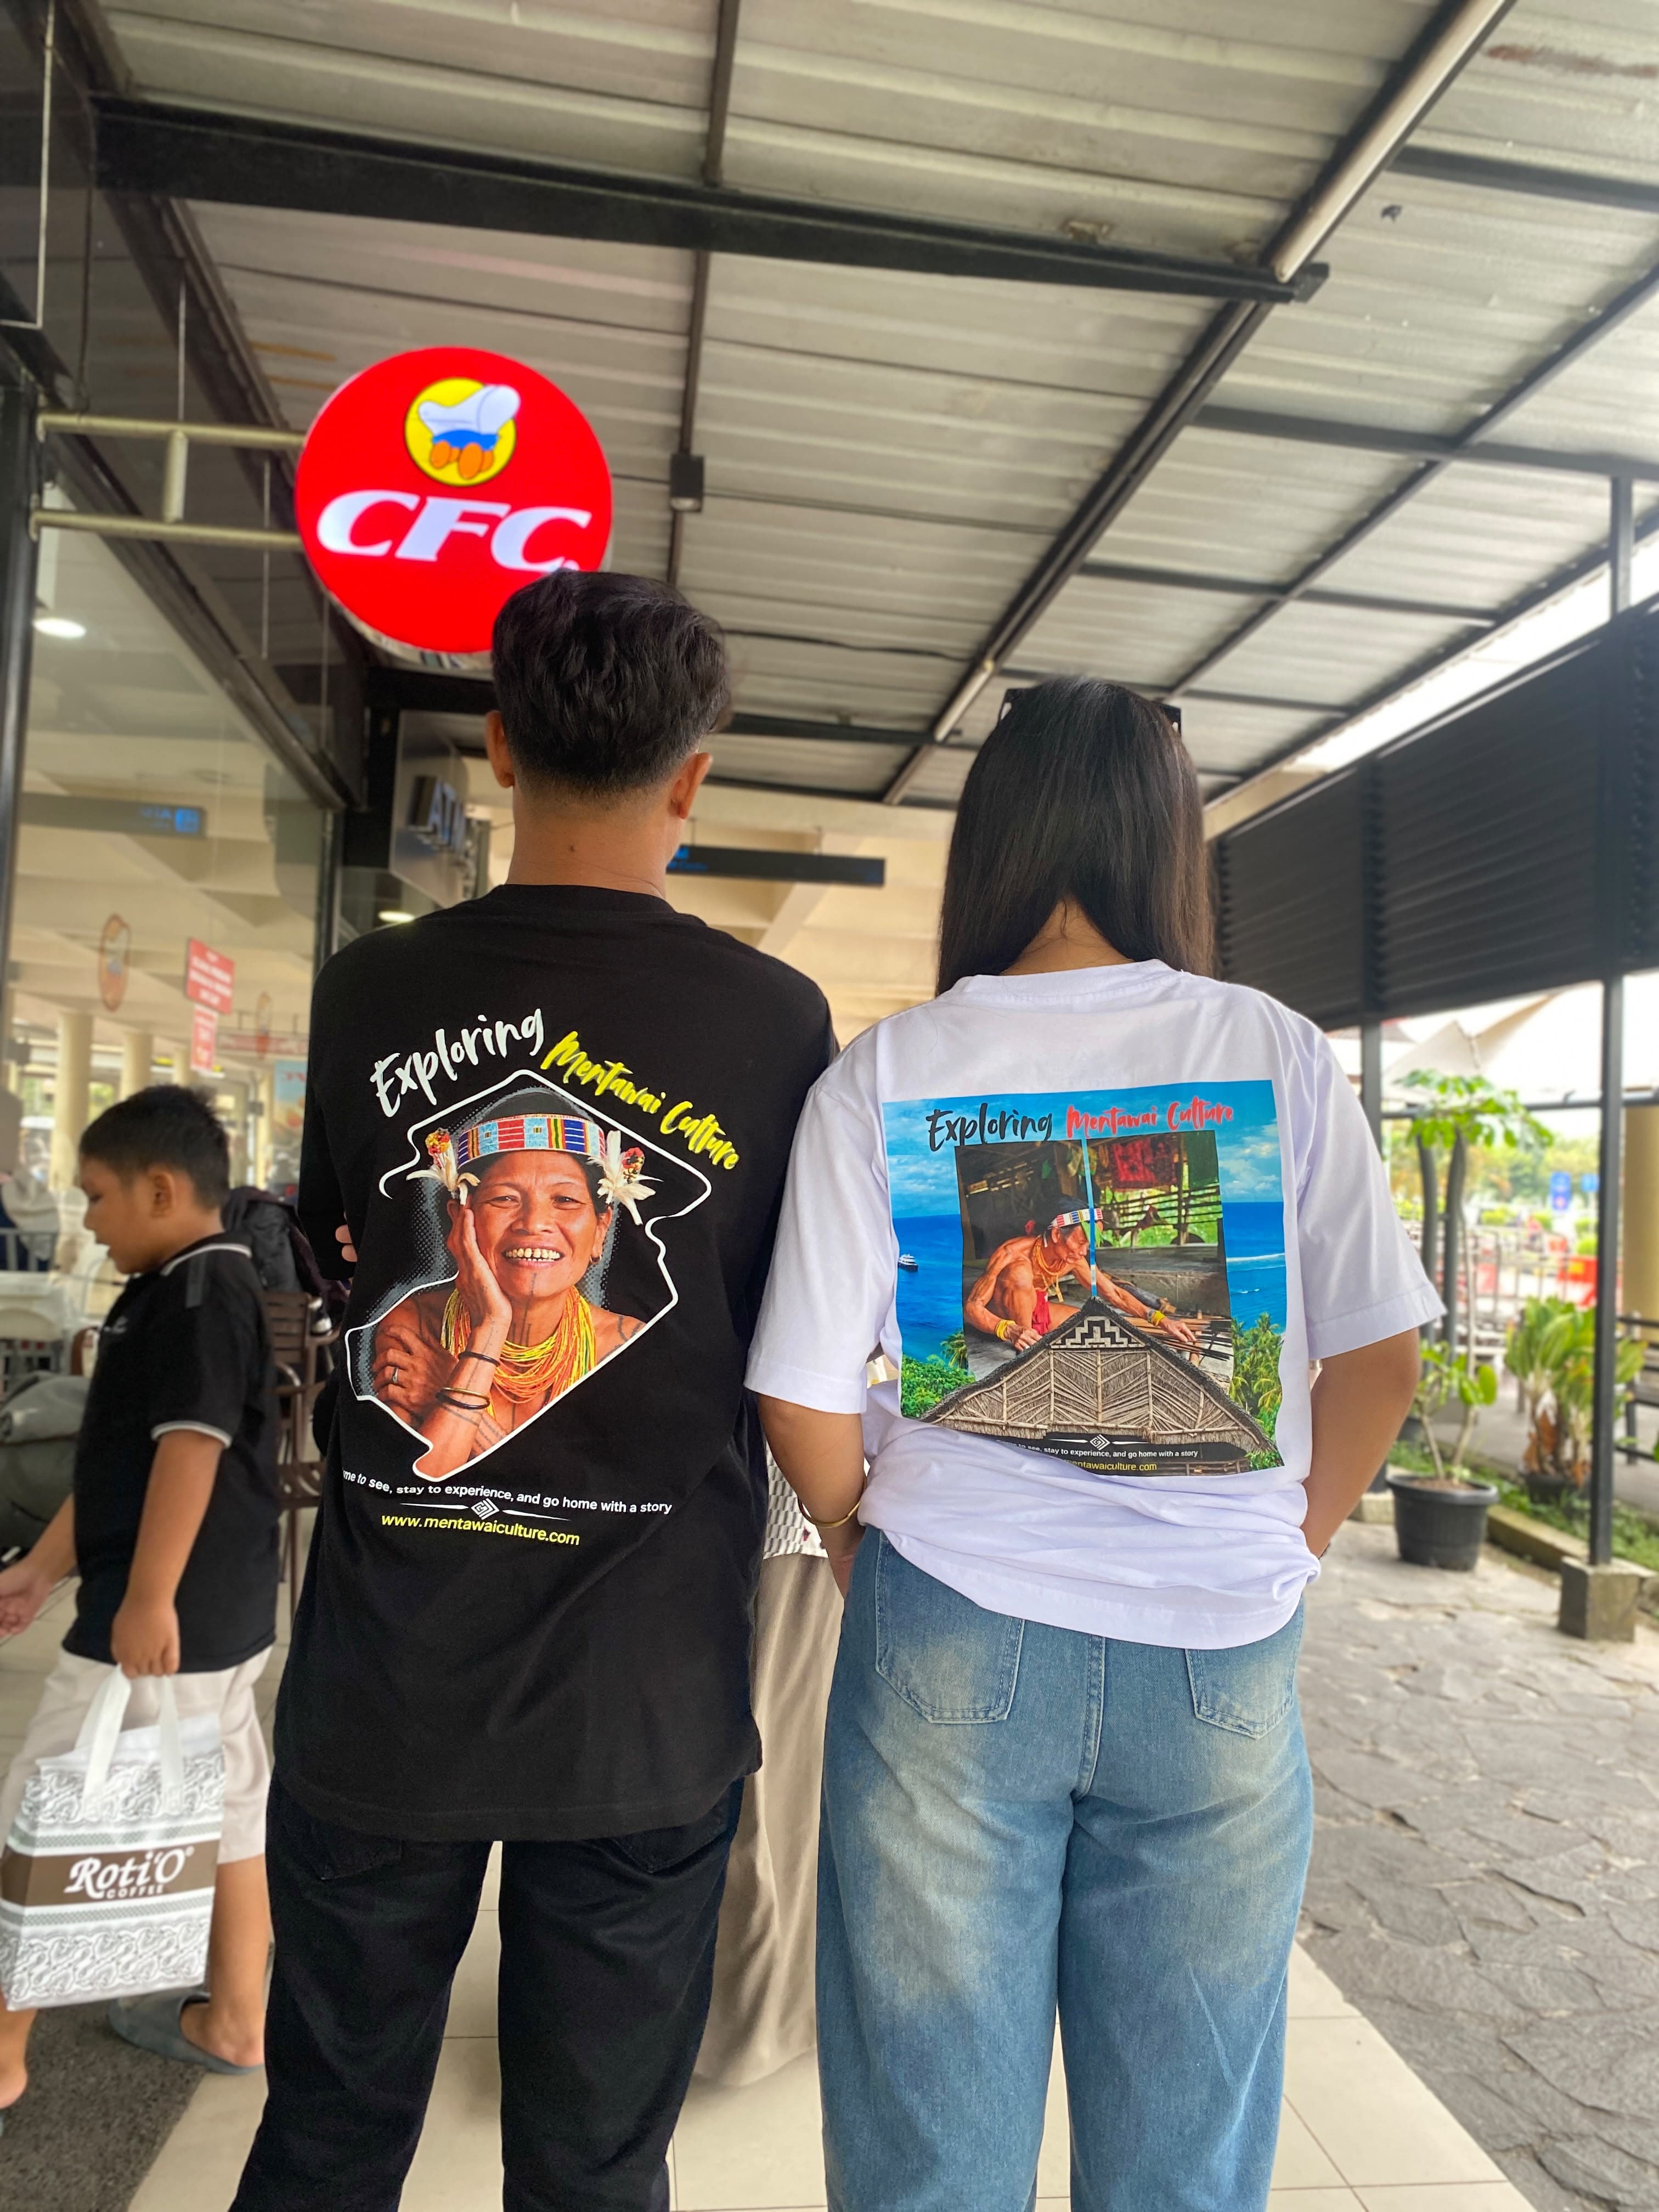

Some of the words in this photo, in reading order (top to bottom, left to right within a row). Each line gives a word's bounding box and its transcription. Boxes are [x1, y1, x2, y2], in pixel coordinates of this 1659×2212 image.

[370, 1008, 544, 1118] Exploring
[541, 1031, 666, 1114] Mentawai
[660, 1101, 741, 1171] Culture
[926, 1103, 1053, 1152] Exploring
[1065, 1105, 1157, 1139] Mentawai
[1166, 1096, 1233, 1131] Culture
[357, 1473, 366, 1485] to
[368, 1479, 392, 1494] see,
[396, 1486, 425, 1495] stay
[444, 1486, 514, 1502] experience,
[516, 1493, 541, 1505] and
[543, 1497, 560, 1508] go
[562, 1497, 597, 1510] home
[601, 1500, 627, 1513] with
[629, 1504, 637, 1513] a
[640, 1503, 673, 1514] story
[381, 1515, 580, 1545] www.mentawaiculture.com
[106, 1884, 164, 1899] COFFEE
